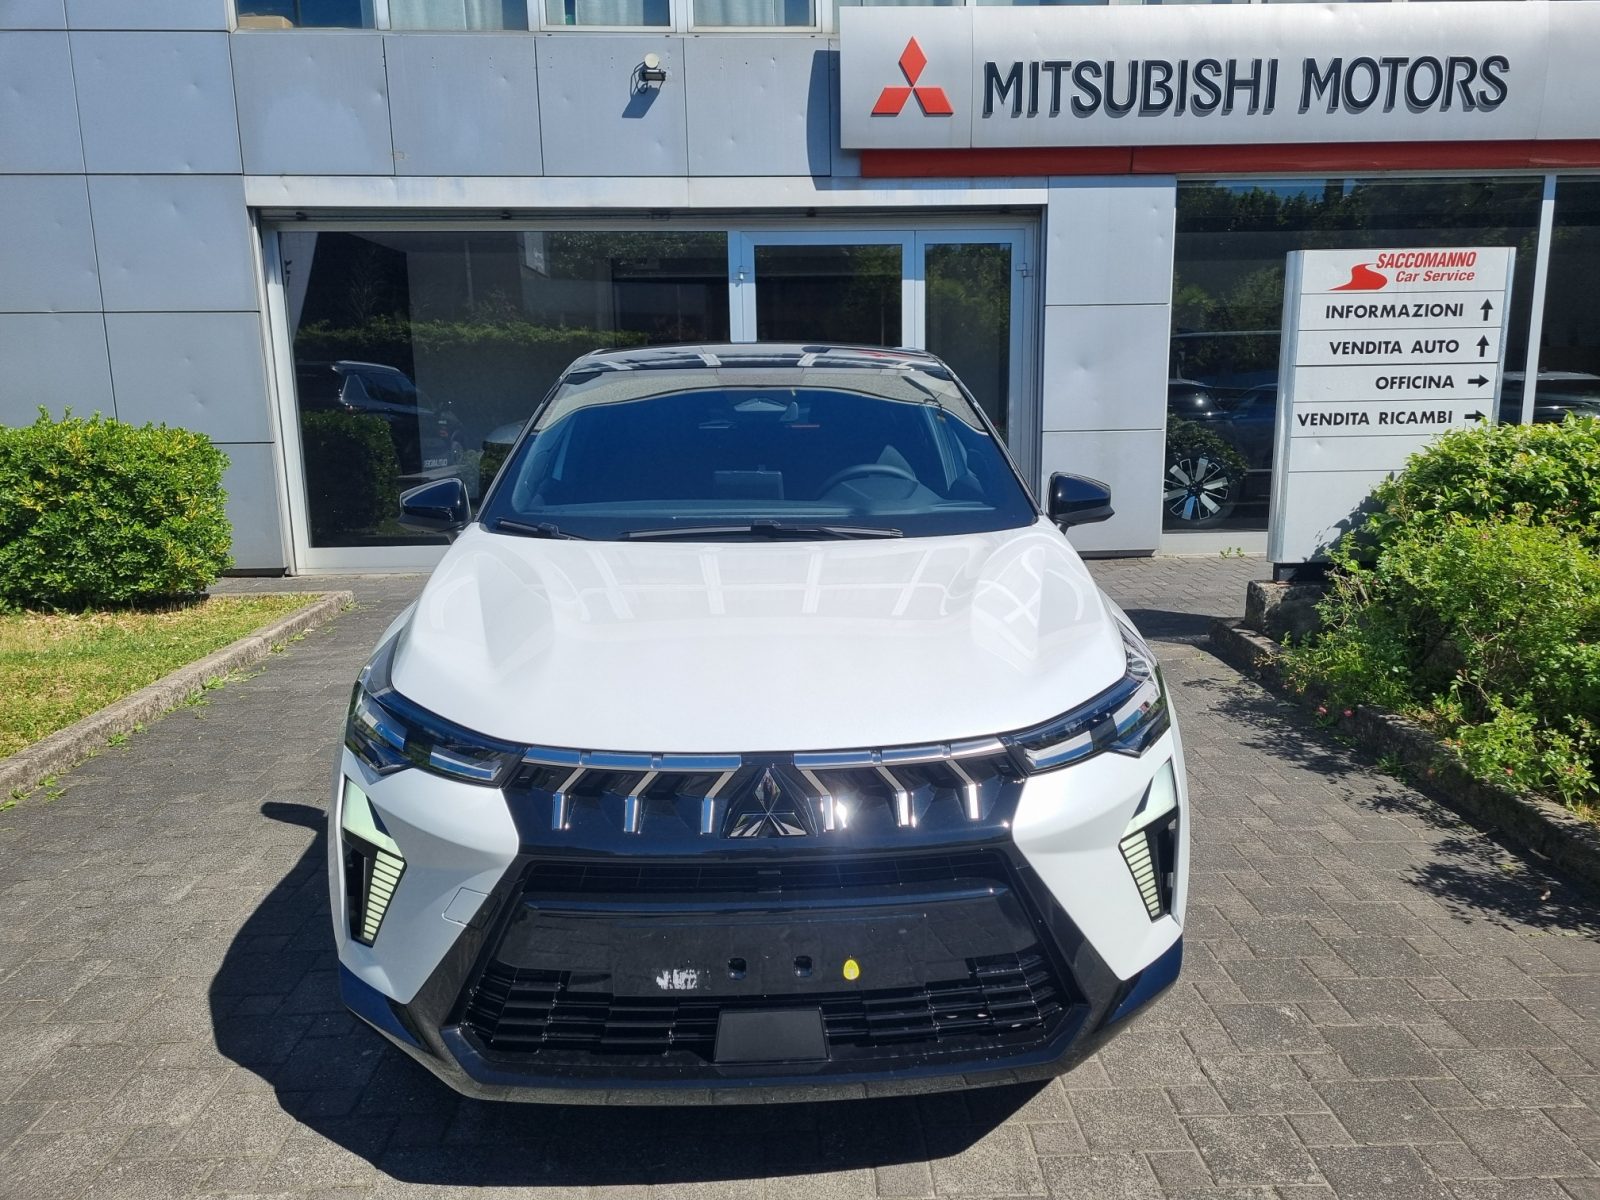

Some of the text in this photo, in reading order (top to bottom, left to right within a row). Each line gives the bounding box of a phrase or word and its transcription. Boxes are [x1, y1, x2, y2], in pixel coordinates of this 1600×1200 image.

[983, 55, 1511, 116] MITSUBISHI MOTORS
[1375, 251, 1477, 269] SACCOMANNO
[1395, 270, 1475, 283] Car Service
[1325, 303, 1464, 319] INFORMAZIONI
[1328, 339, 1460, 355] VENDITA AUTO
[1374, 375, 1455, 389] OFFICINA
[1297, 410, 1453, 426] VENDITA RICAMBI
